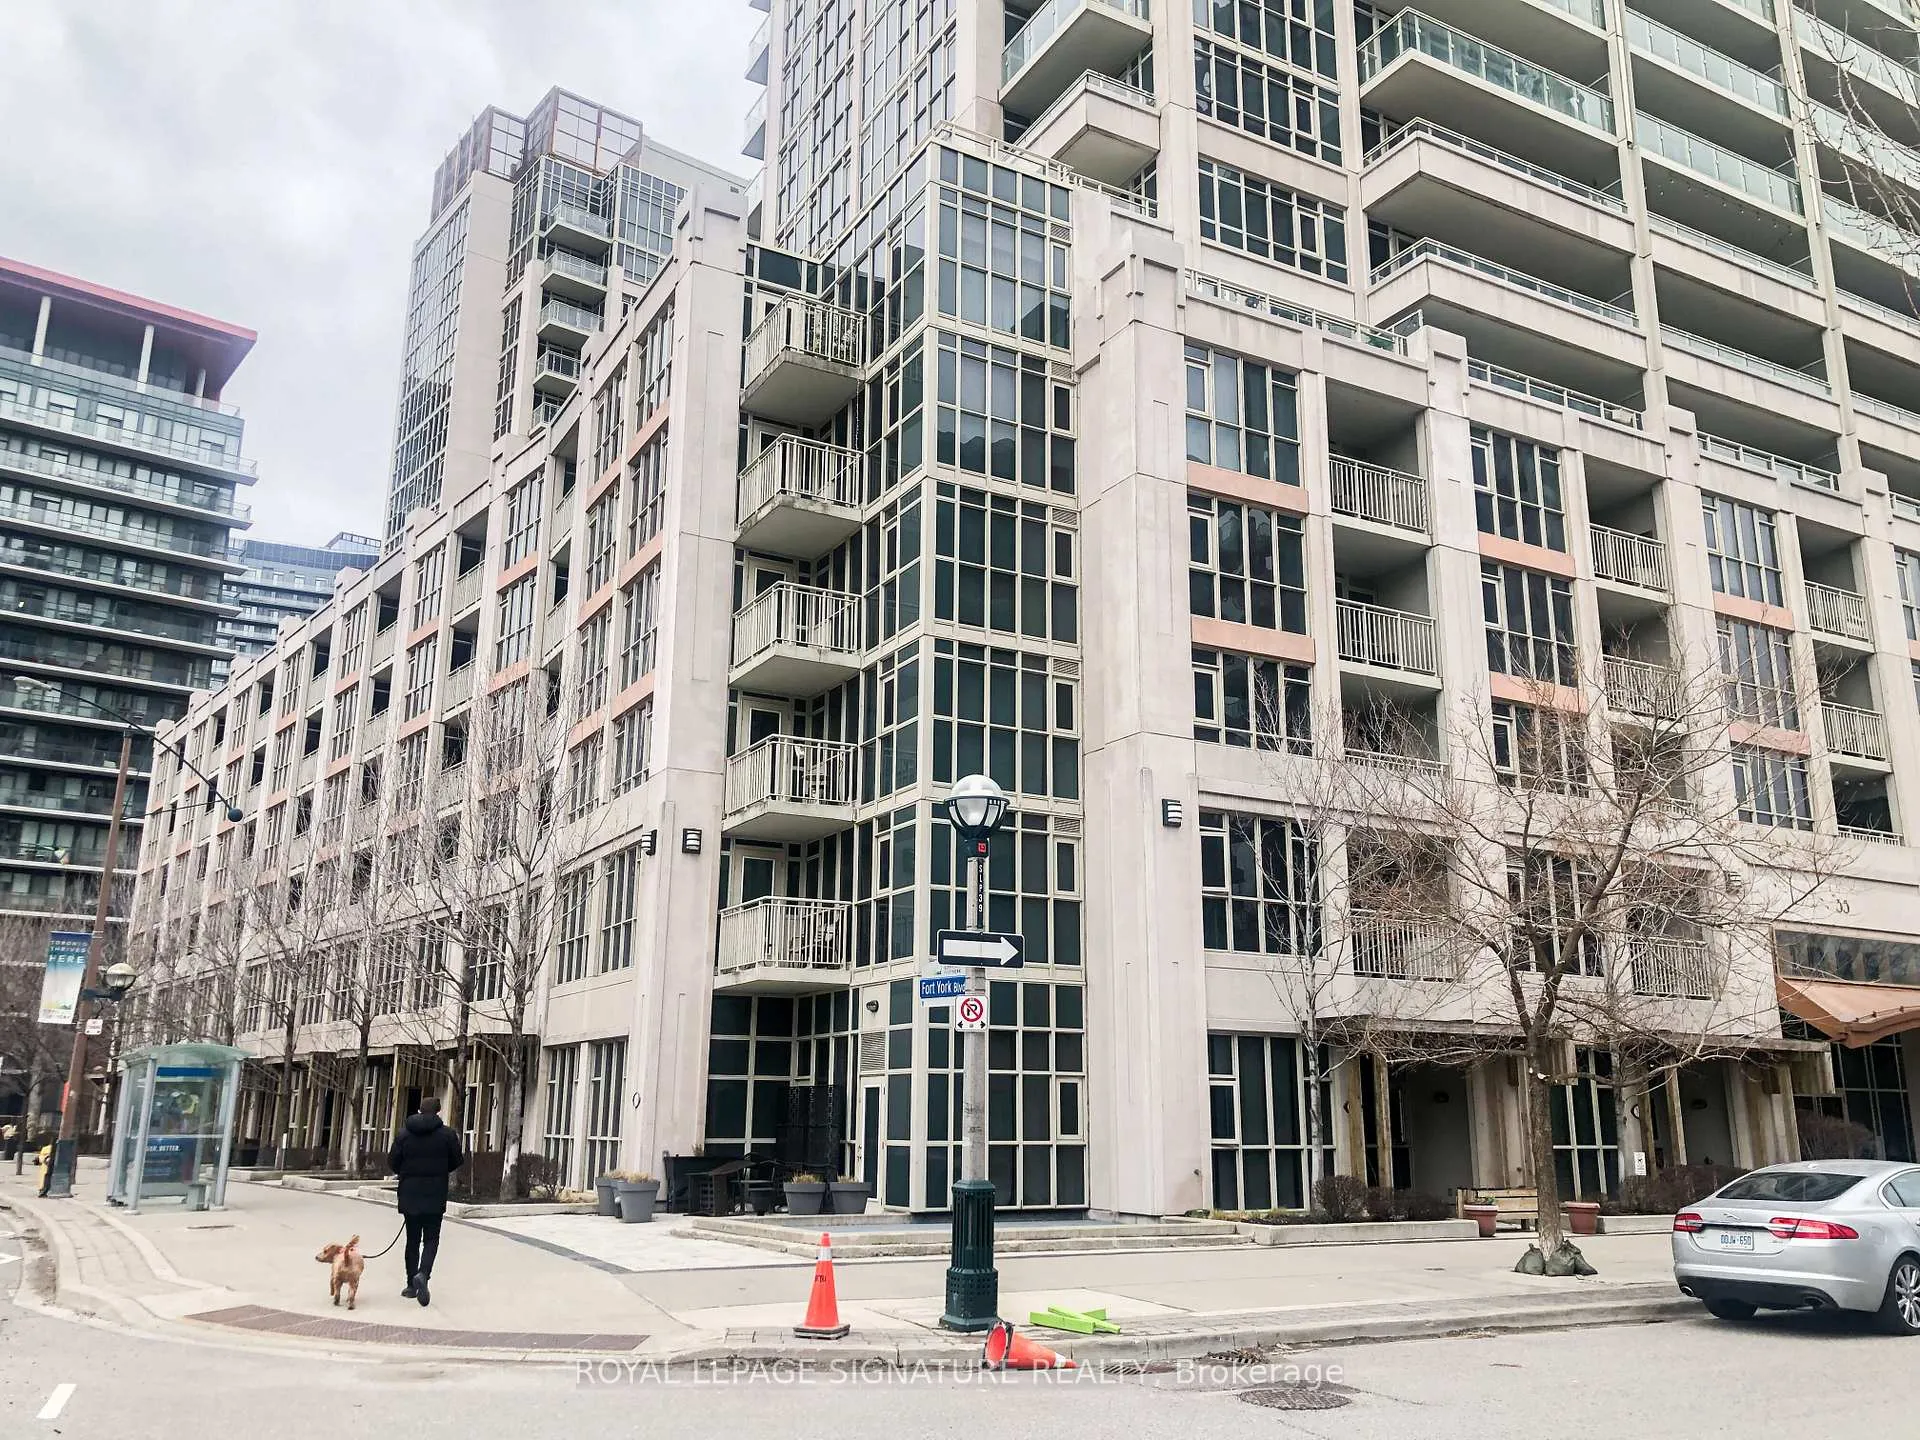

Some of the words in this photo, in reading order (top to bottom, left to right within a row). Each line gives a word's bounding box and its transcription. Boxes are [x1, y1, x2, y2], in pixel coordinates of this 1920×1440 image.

[48, 954, 86, 964] HERE
[921, 981, 936, 995] Fort
[936, 980, 952, 994] York
